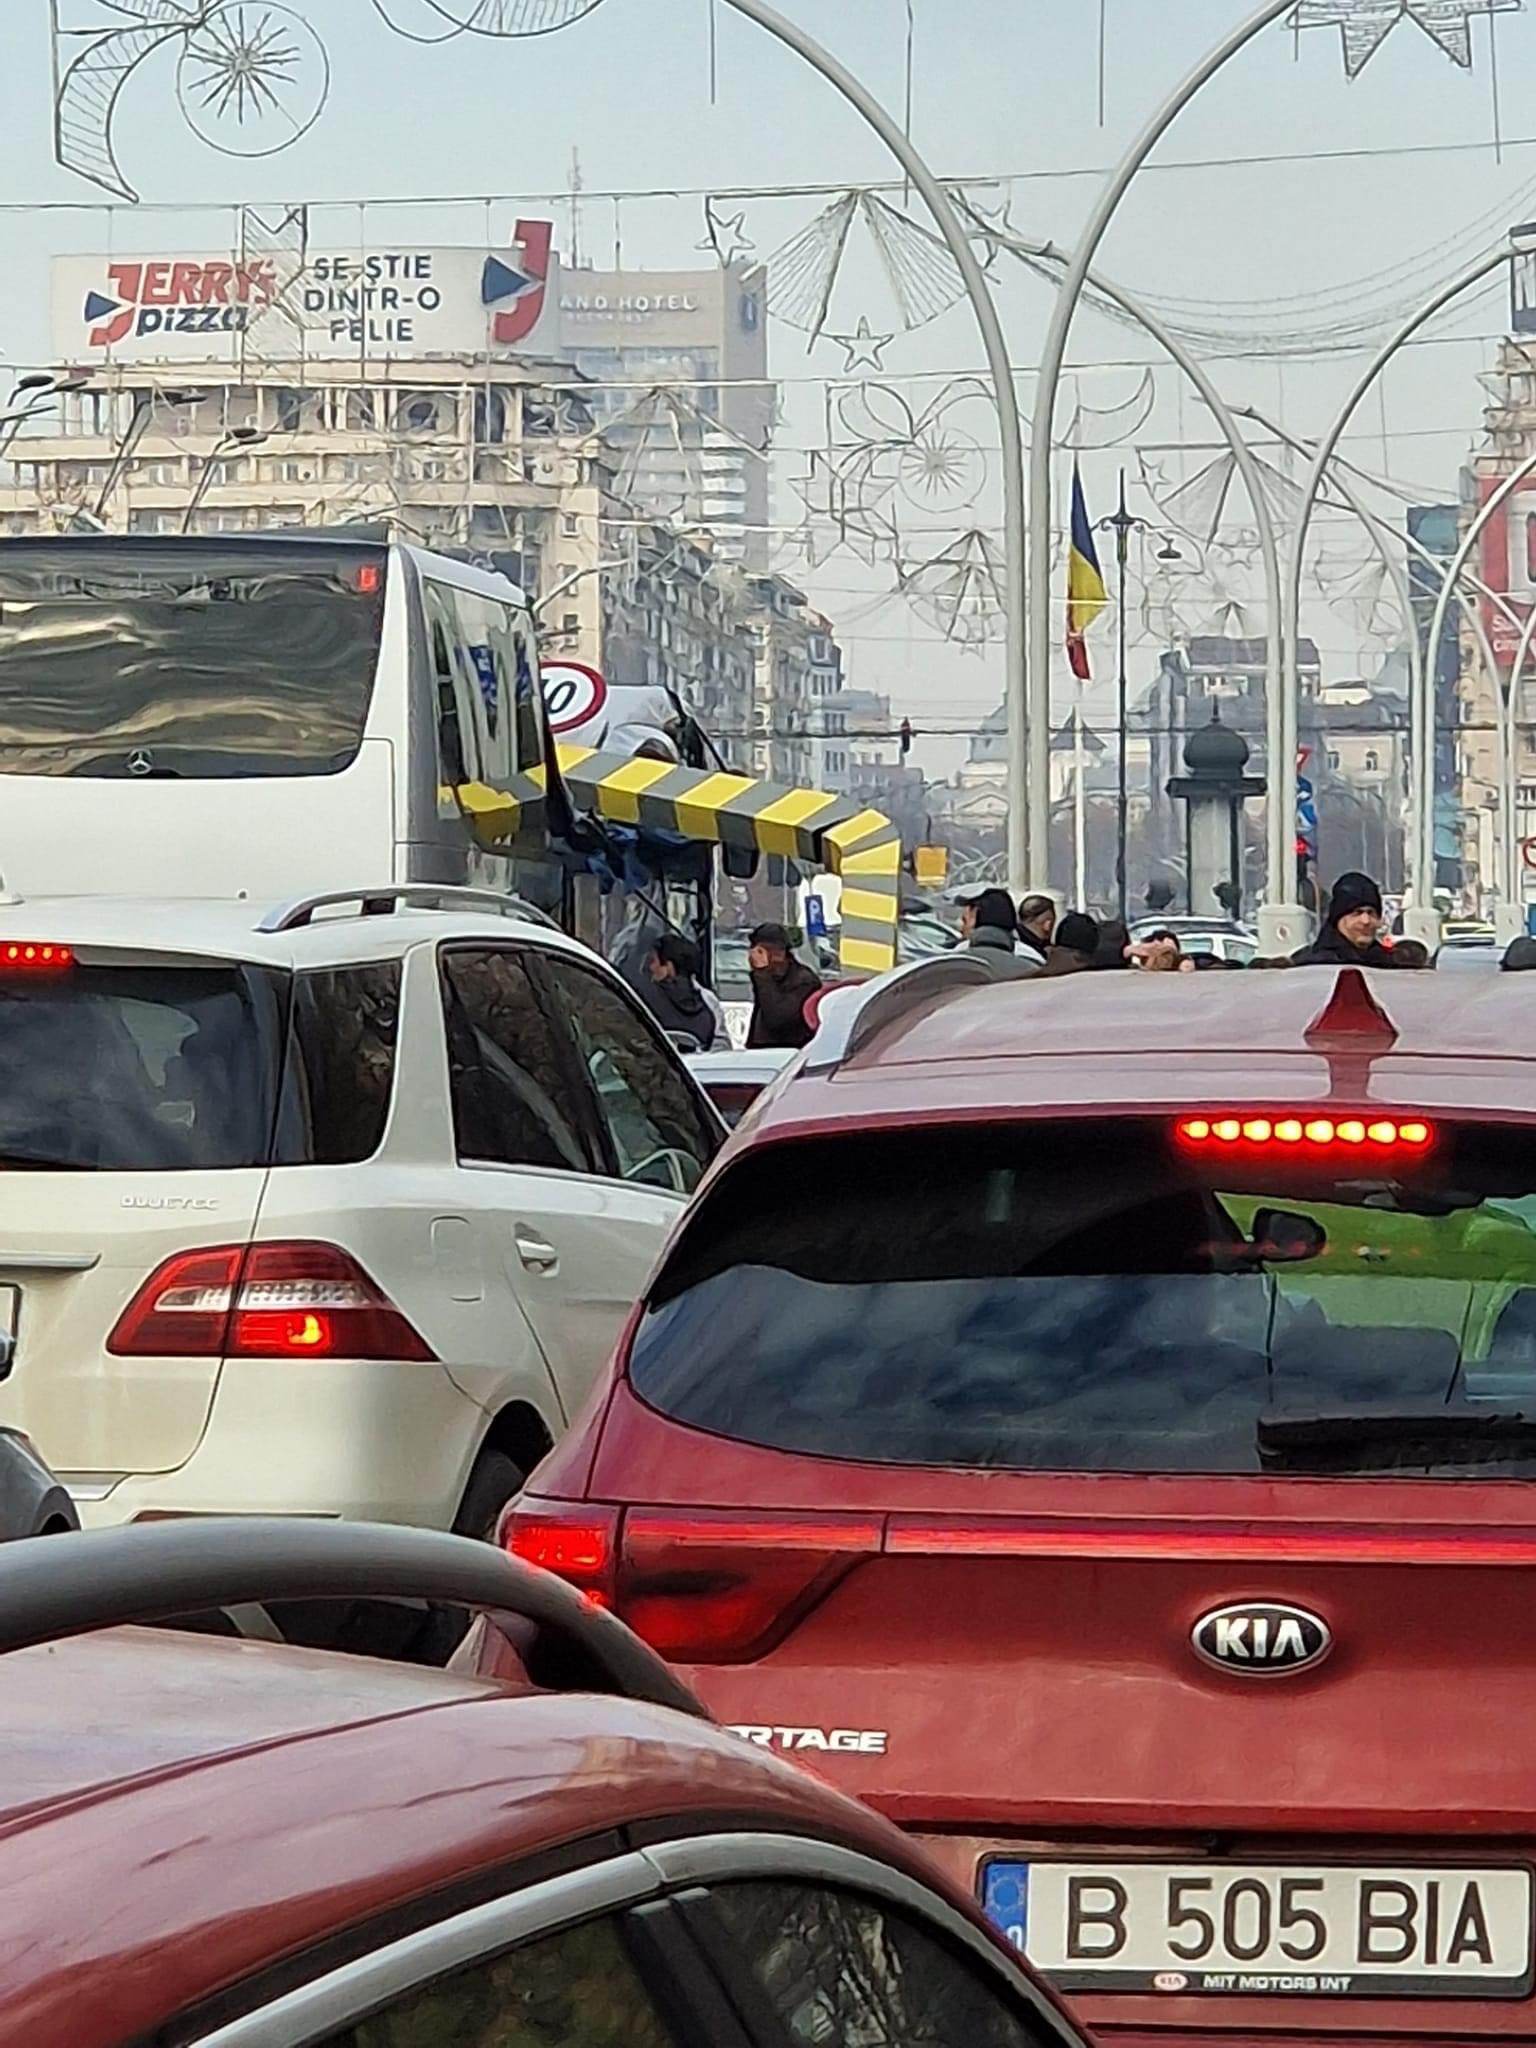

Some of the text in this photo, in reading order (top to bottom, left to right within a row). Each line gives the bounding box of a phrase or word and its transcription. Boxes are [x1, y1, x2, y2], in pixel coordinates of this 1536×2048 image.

[313, 257, 348, 280] SE
[304, 286, 441, 312] DINTR-O
[619, 294, 697, 312] HOTEL
[330, 318, 414, 342] FELIE
[1215, 1617, 1308, 1659] KIA
[725, 1724, 889, 1754] RTAGE
[1066, 1876, 1494, 1965] B 505 BIA
[1203, 1974, 1351, 1991] MIT MOTORS INT
